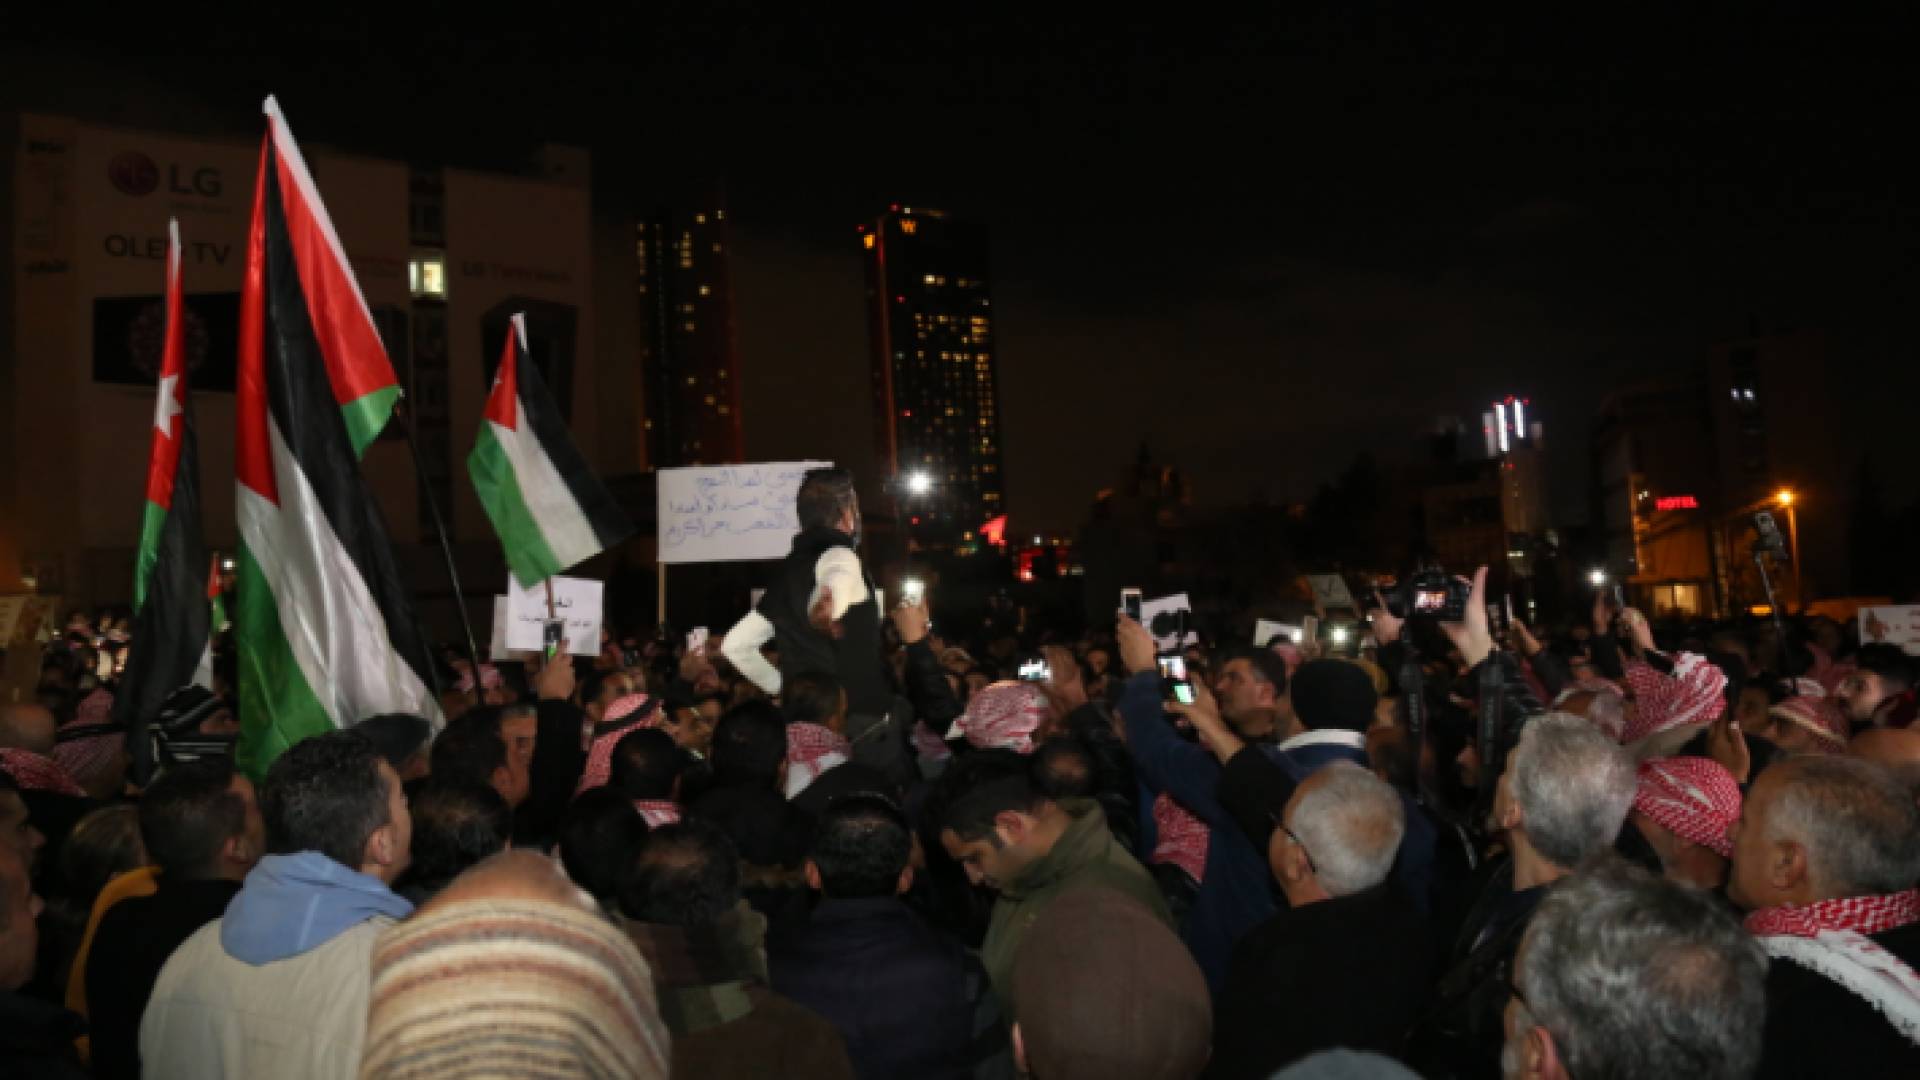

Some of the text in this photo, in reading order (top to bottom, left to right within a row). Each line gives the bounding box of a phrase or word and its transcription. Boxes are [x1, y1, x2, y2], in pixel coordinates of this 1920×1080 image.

[169, 163, 223, 197] LG
[104, 234, 232, 265] OLE TV
